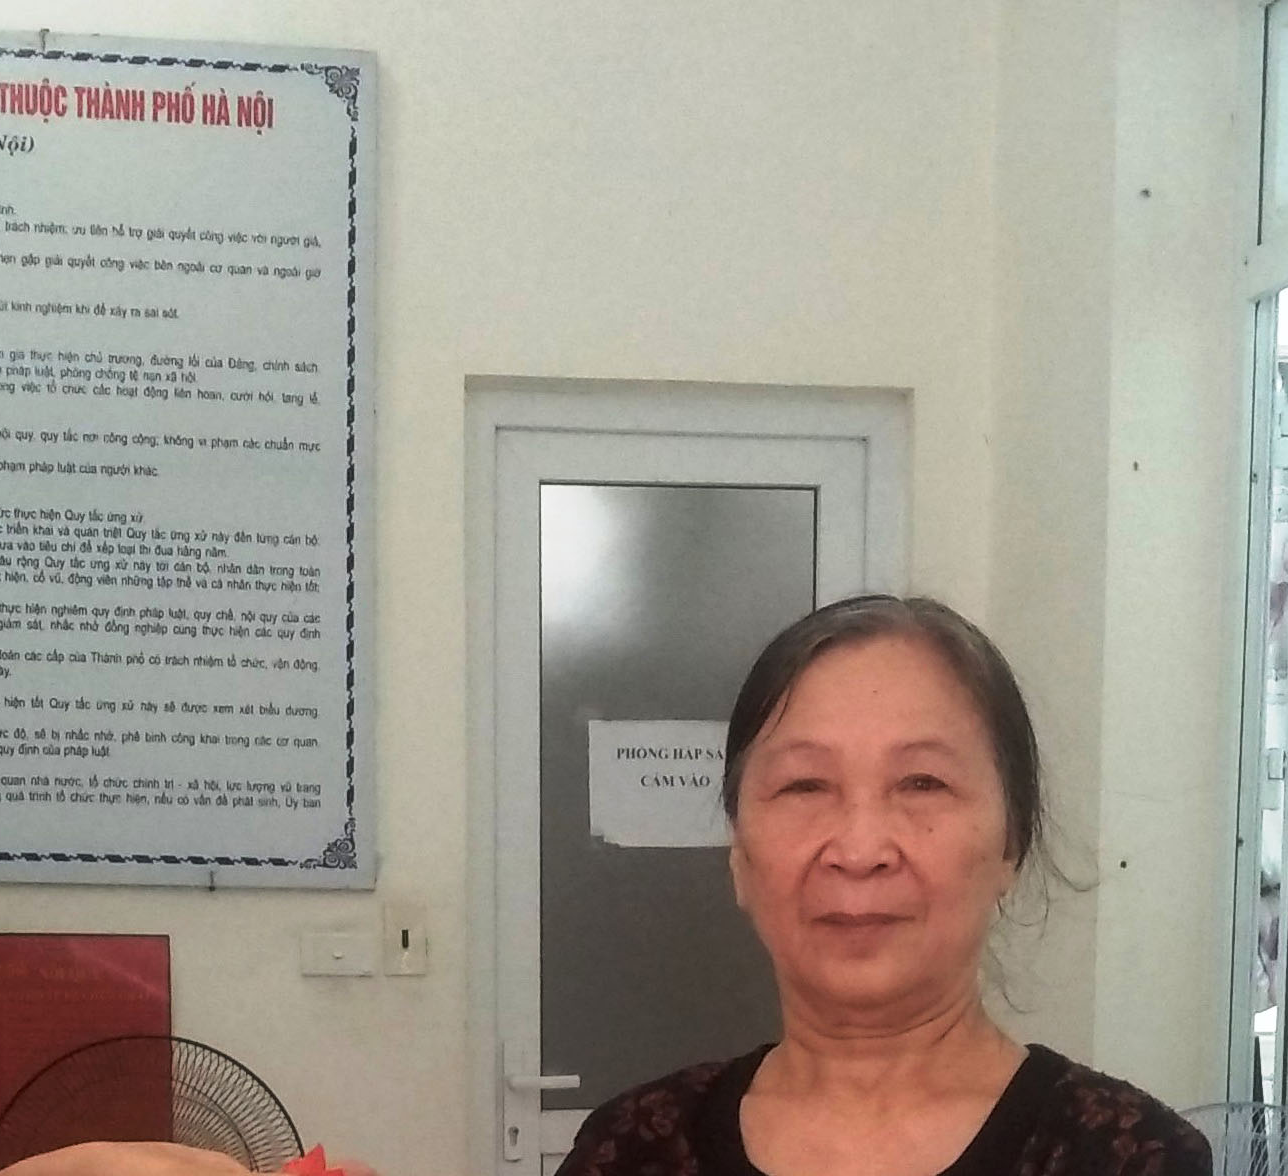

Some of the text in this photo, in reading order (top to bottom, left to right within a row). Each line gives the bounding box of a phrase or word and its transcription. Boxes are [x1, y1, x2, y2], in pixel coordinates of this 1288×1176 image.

[73, 81, 145, 122] THÀNH
[151, 80, 197, 124] PHỐ
[201, 88, 229, 126] HÀ
[237, 90, 273, 135] NỘI
